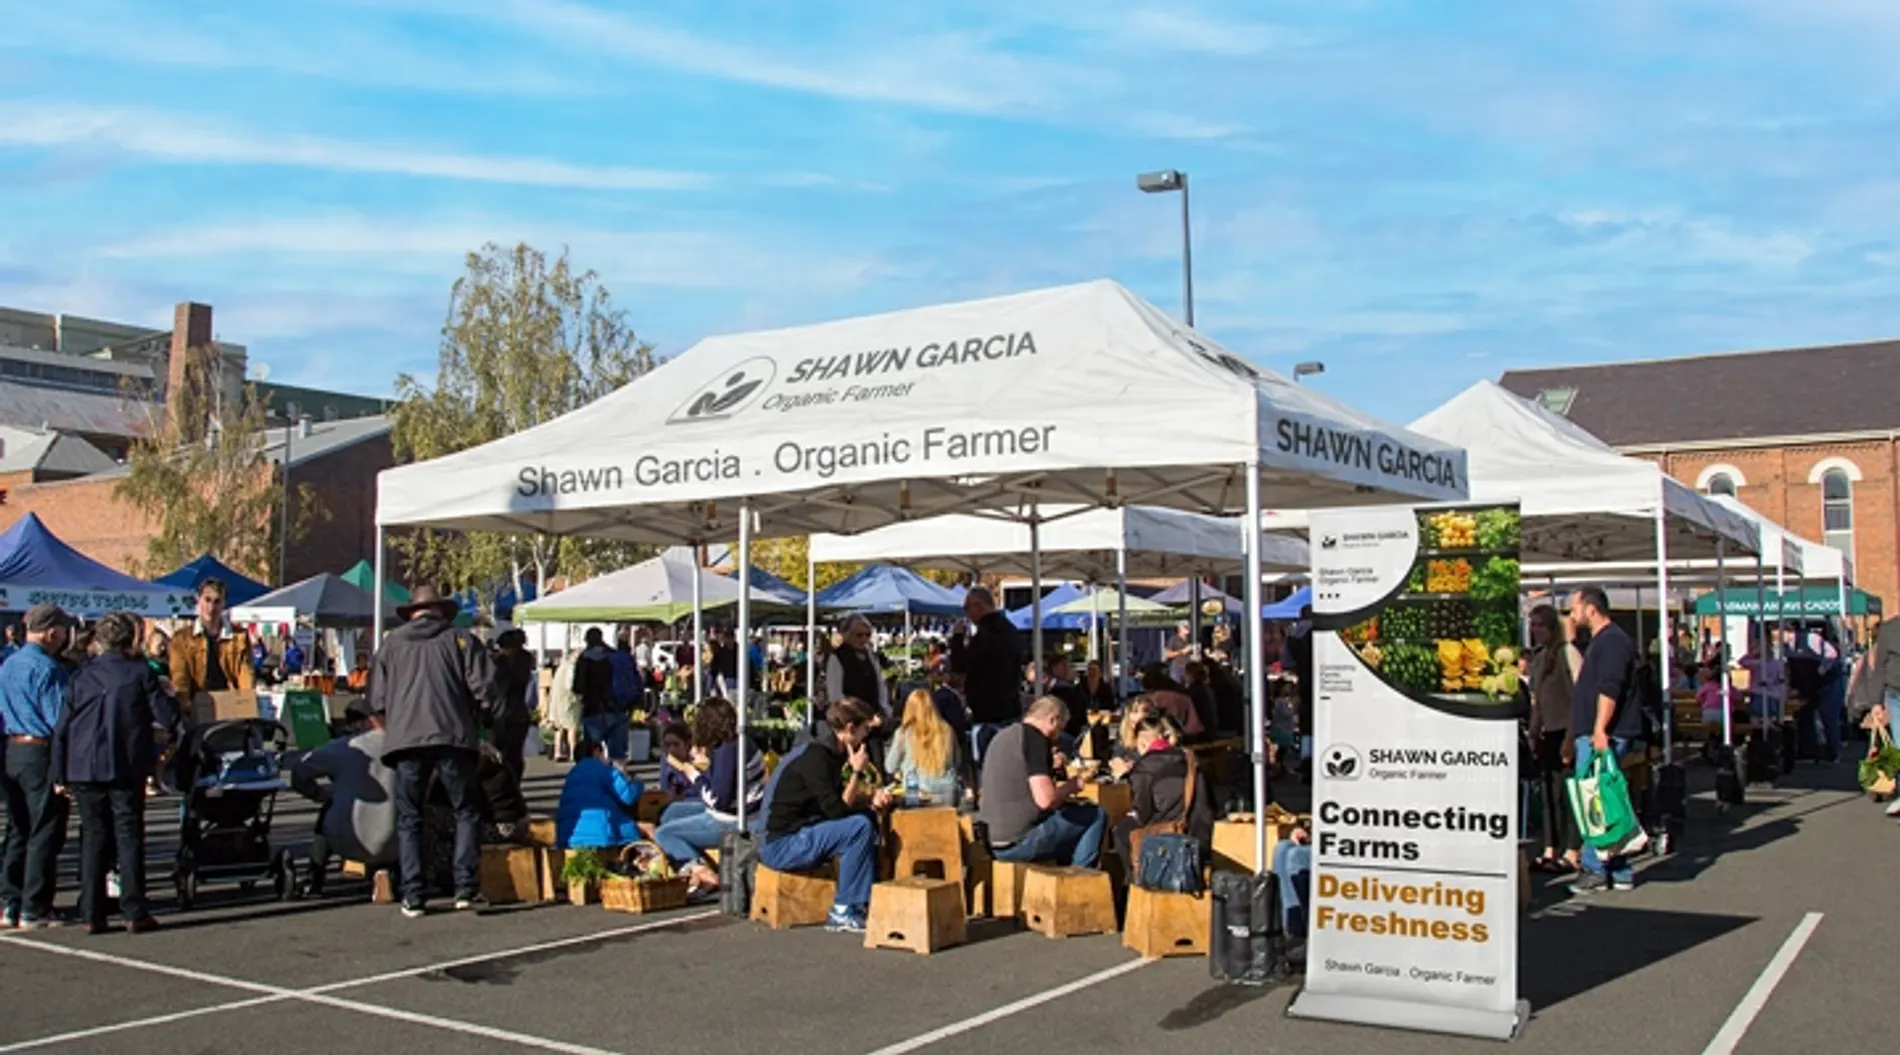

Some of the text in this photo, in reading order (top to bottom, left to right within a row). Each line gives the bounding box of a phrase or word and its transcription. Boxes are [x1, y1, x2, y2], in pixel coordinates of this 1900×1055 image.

[786, 331, 1038, 384] SHAWN GARCIA
[762, 380, 916, 412] Organic Farmer
[516, 463, 623, 498] Shawn
[634, 448, 741, 486] Garcia
[774, 432, 911, 479] Organic
[923, 425, 1057, 460] Farmer
[1276, 418, 1456, 489] SHAWN GARCIA
[1369, 748, 1509, 767] SHAWN GARCIA
[1369, 768, 1447, 780] Organic Farmer
[1319, 801, 1508, 840] Connecting
[1318, 832, 1420, 861] Farms
[1317, 874, 1486, 916] Delivering
[1316, 906, 1490, 943] Freshness
[1325, 959, 1362, 974] Shawn
[1364, 963, 1401, 977] Garcia
[1409, 967, 1453, 983] Organic
[1456, 971, 1497, 986] Farmer
